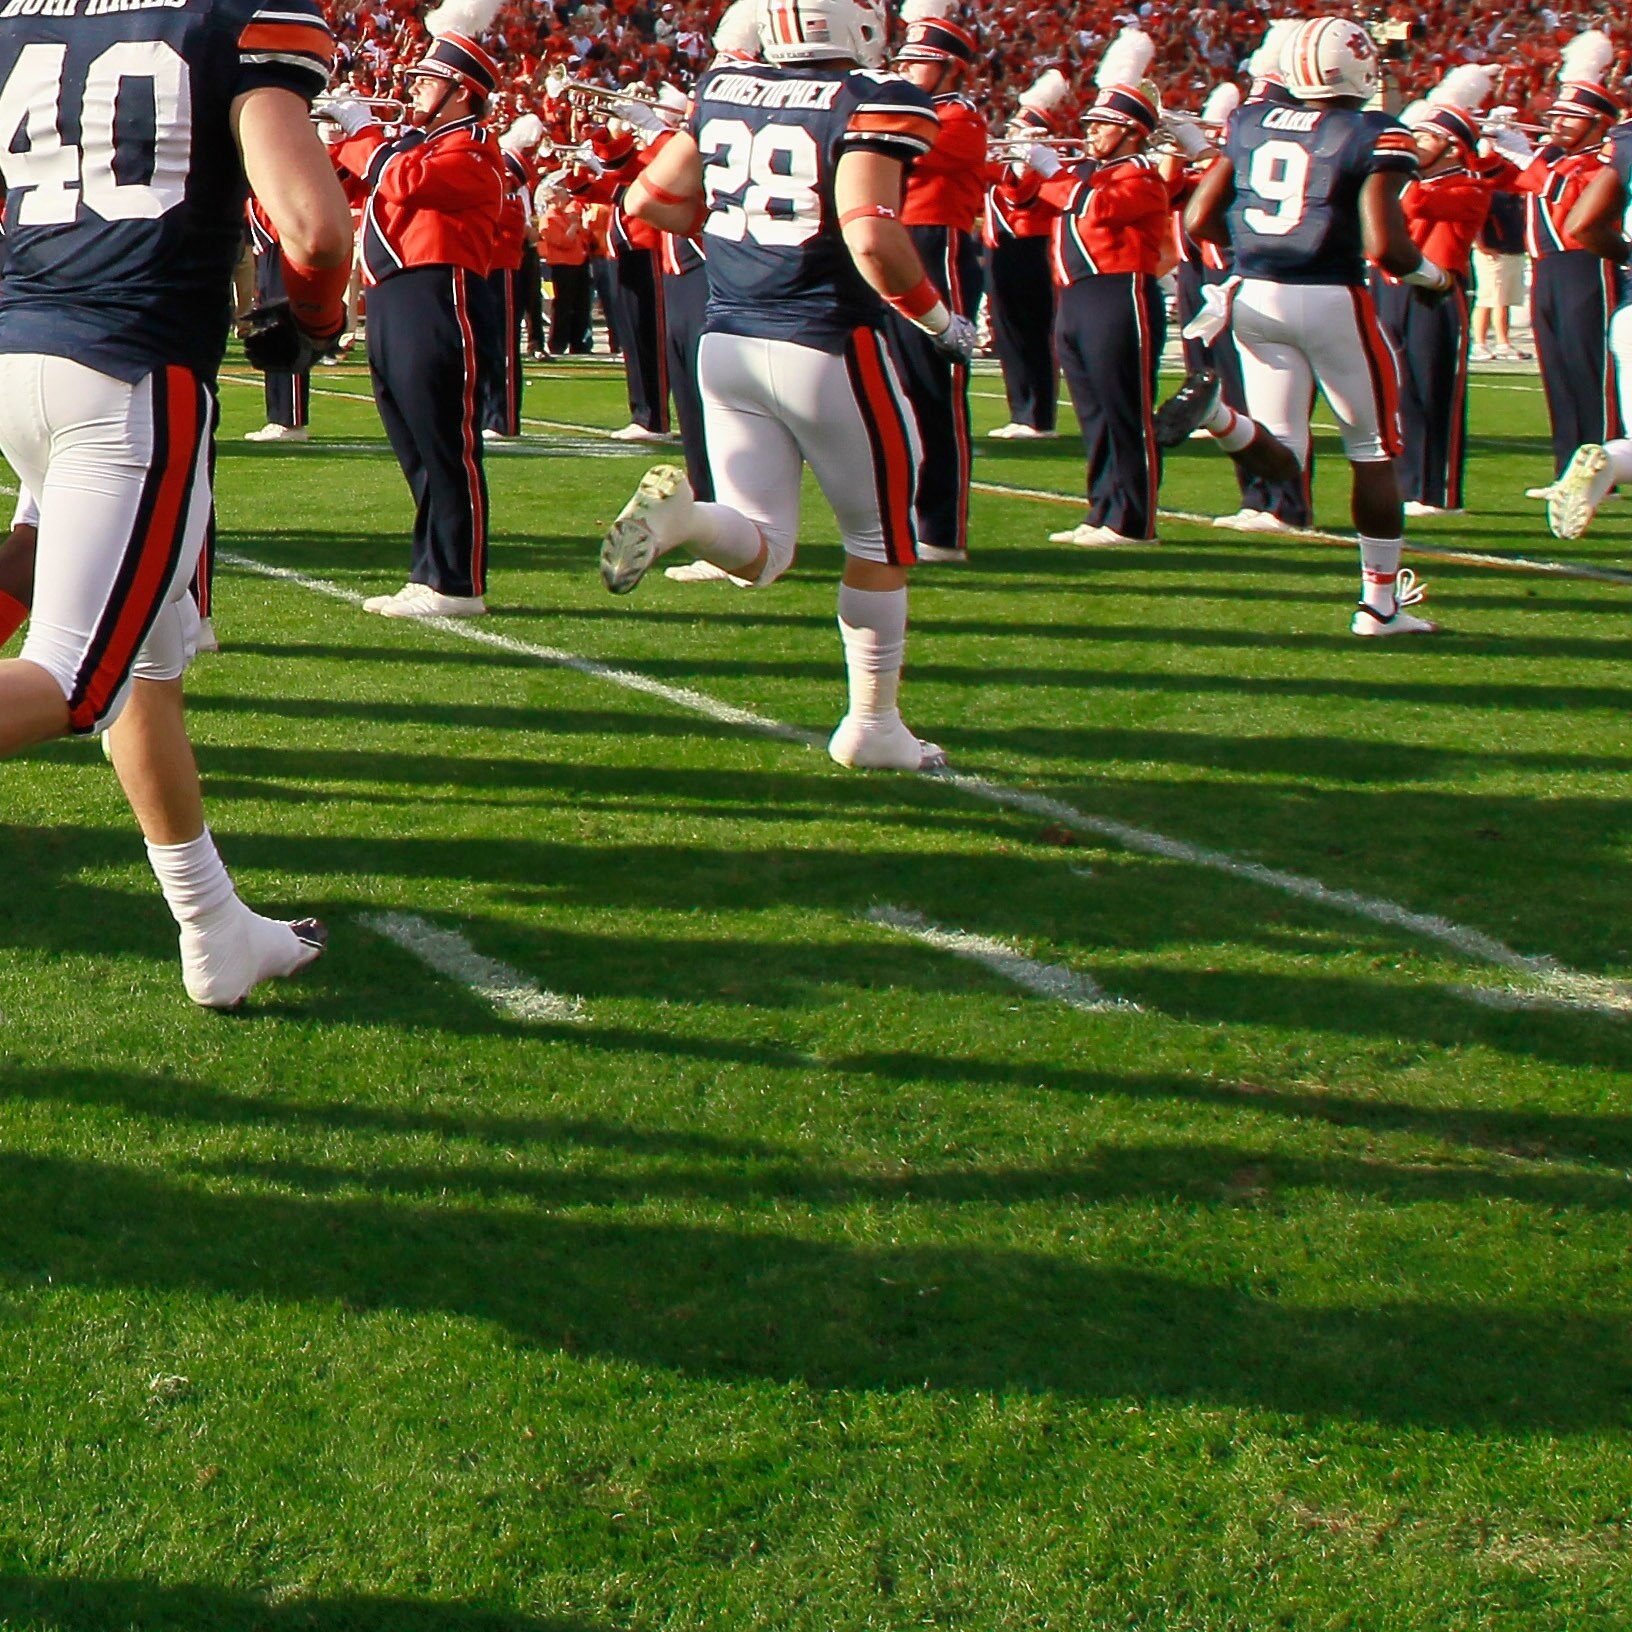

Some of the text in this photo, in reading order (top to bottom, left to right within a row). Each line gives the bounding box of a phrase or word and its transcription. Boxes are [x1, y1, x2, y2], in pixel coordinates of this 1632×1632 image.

[703, 73, 842, 110] CHRISTOPHER
[1262, 107, 1322, 132] CARR
[698, 118, 822, 247] 28
[1243, 139, 1312, 236] 9
